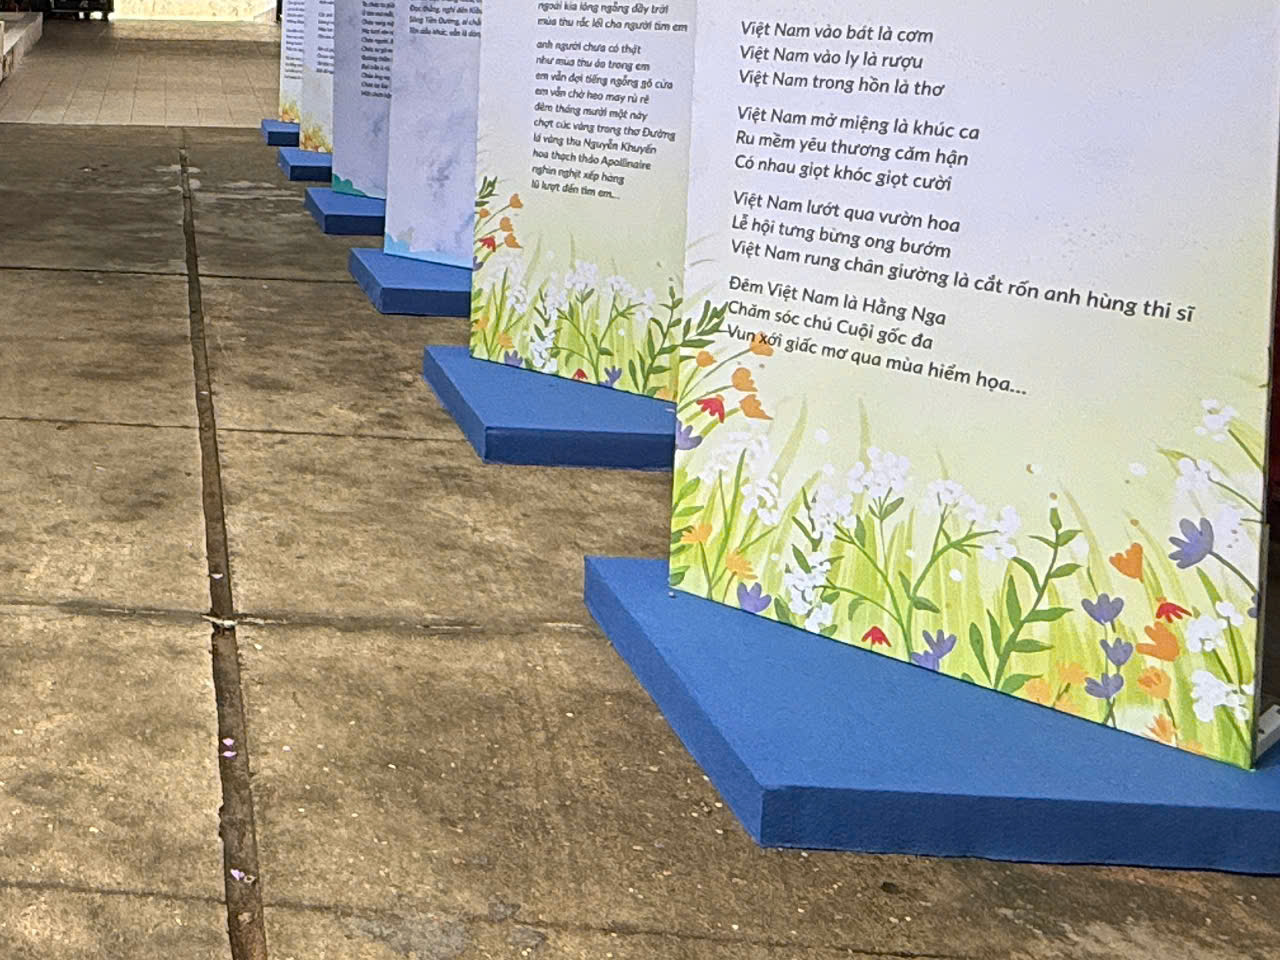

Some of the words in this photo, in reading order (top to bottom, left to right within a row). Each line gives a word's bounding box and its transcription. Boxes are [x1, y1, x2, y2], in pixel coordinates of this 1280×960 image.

[742, 21, 770, 38] Việt
[774, 23, 810, 37] Nam
[815, 24, 842, 38] vào
[846, 25, 874, 40] bát
[878, 26, 892, 40] là
[897, 30, 933, 43] cơm
[736, 130, 754, 144] Ru
[759, 132, 795, 149] mềm
[800, 137, 826, 153] yêu
[832, 139, 891, 161] thương
[895, 146, 930, 162] căm
[935, 148, 968, 168] hận
[732, 239, 761, 258] Việt
[765, 244, 800, 262] Nam
[804, 254, 840, 271] rung
[844, 257, 883, 275] chân
[888, 264, 949, 288] giường
[954, 272, 969, 288] là
[974, 275, 1003, 293] cắt
[1008, 281, 1038, 298] rốn
[1044, 288, 1080, 305] anh
[1087, 291, 1137, 316] hùng
[1144, 300, 1171, 318] thi
[1176, 306, 1195, 322] sĩ
